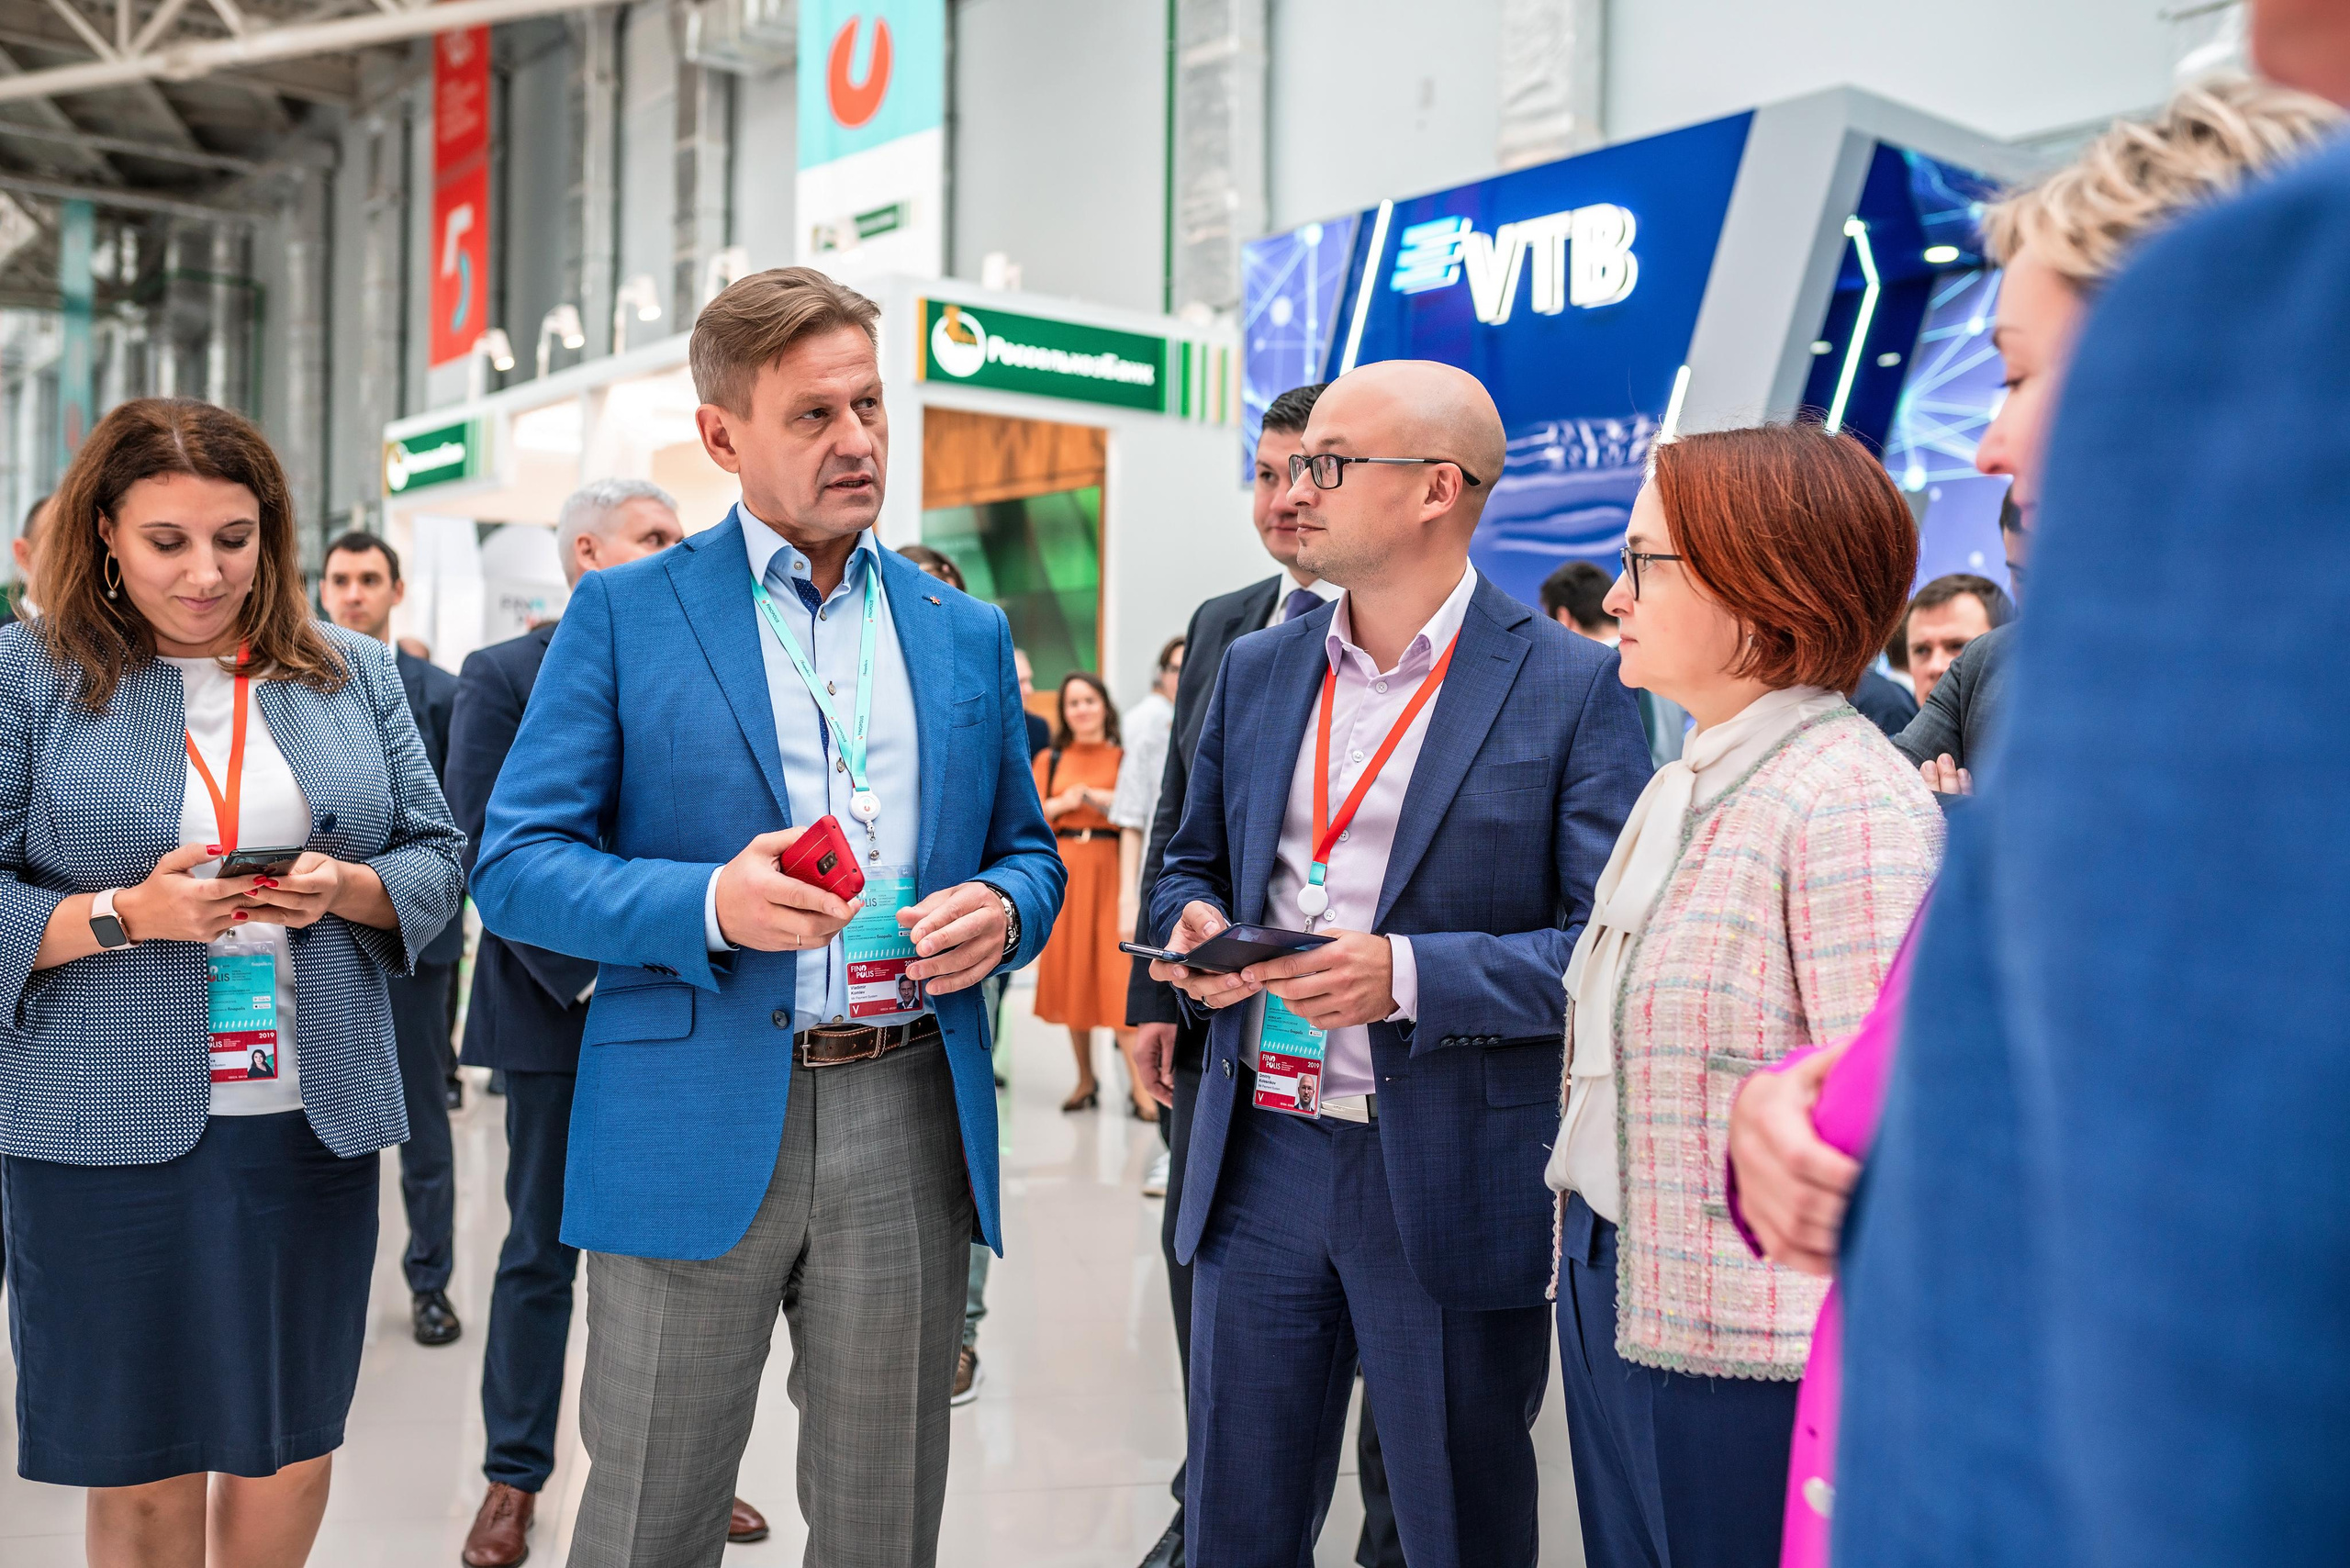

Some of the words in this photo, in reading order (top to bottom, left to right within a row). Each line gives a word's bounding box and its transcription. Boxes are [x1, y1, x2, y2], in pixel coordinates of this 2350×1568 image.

[1464, 203, 1639, 326] VTB
[767, 603, 780, 623] FINOPOLIS
[850, 965, 867, 973] FINO
[856, 970, 875, 980] POLIS
[852, 1004, 859, 1014] V
[1262, 1054, 1276, 1062] FINO
[1266, 1061, 1281, 1070] POLIS
[1258, 1092, 1264, 1103] V
